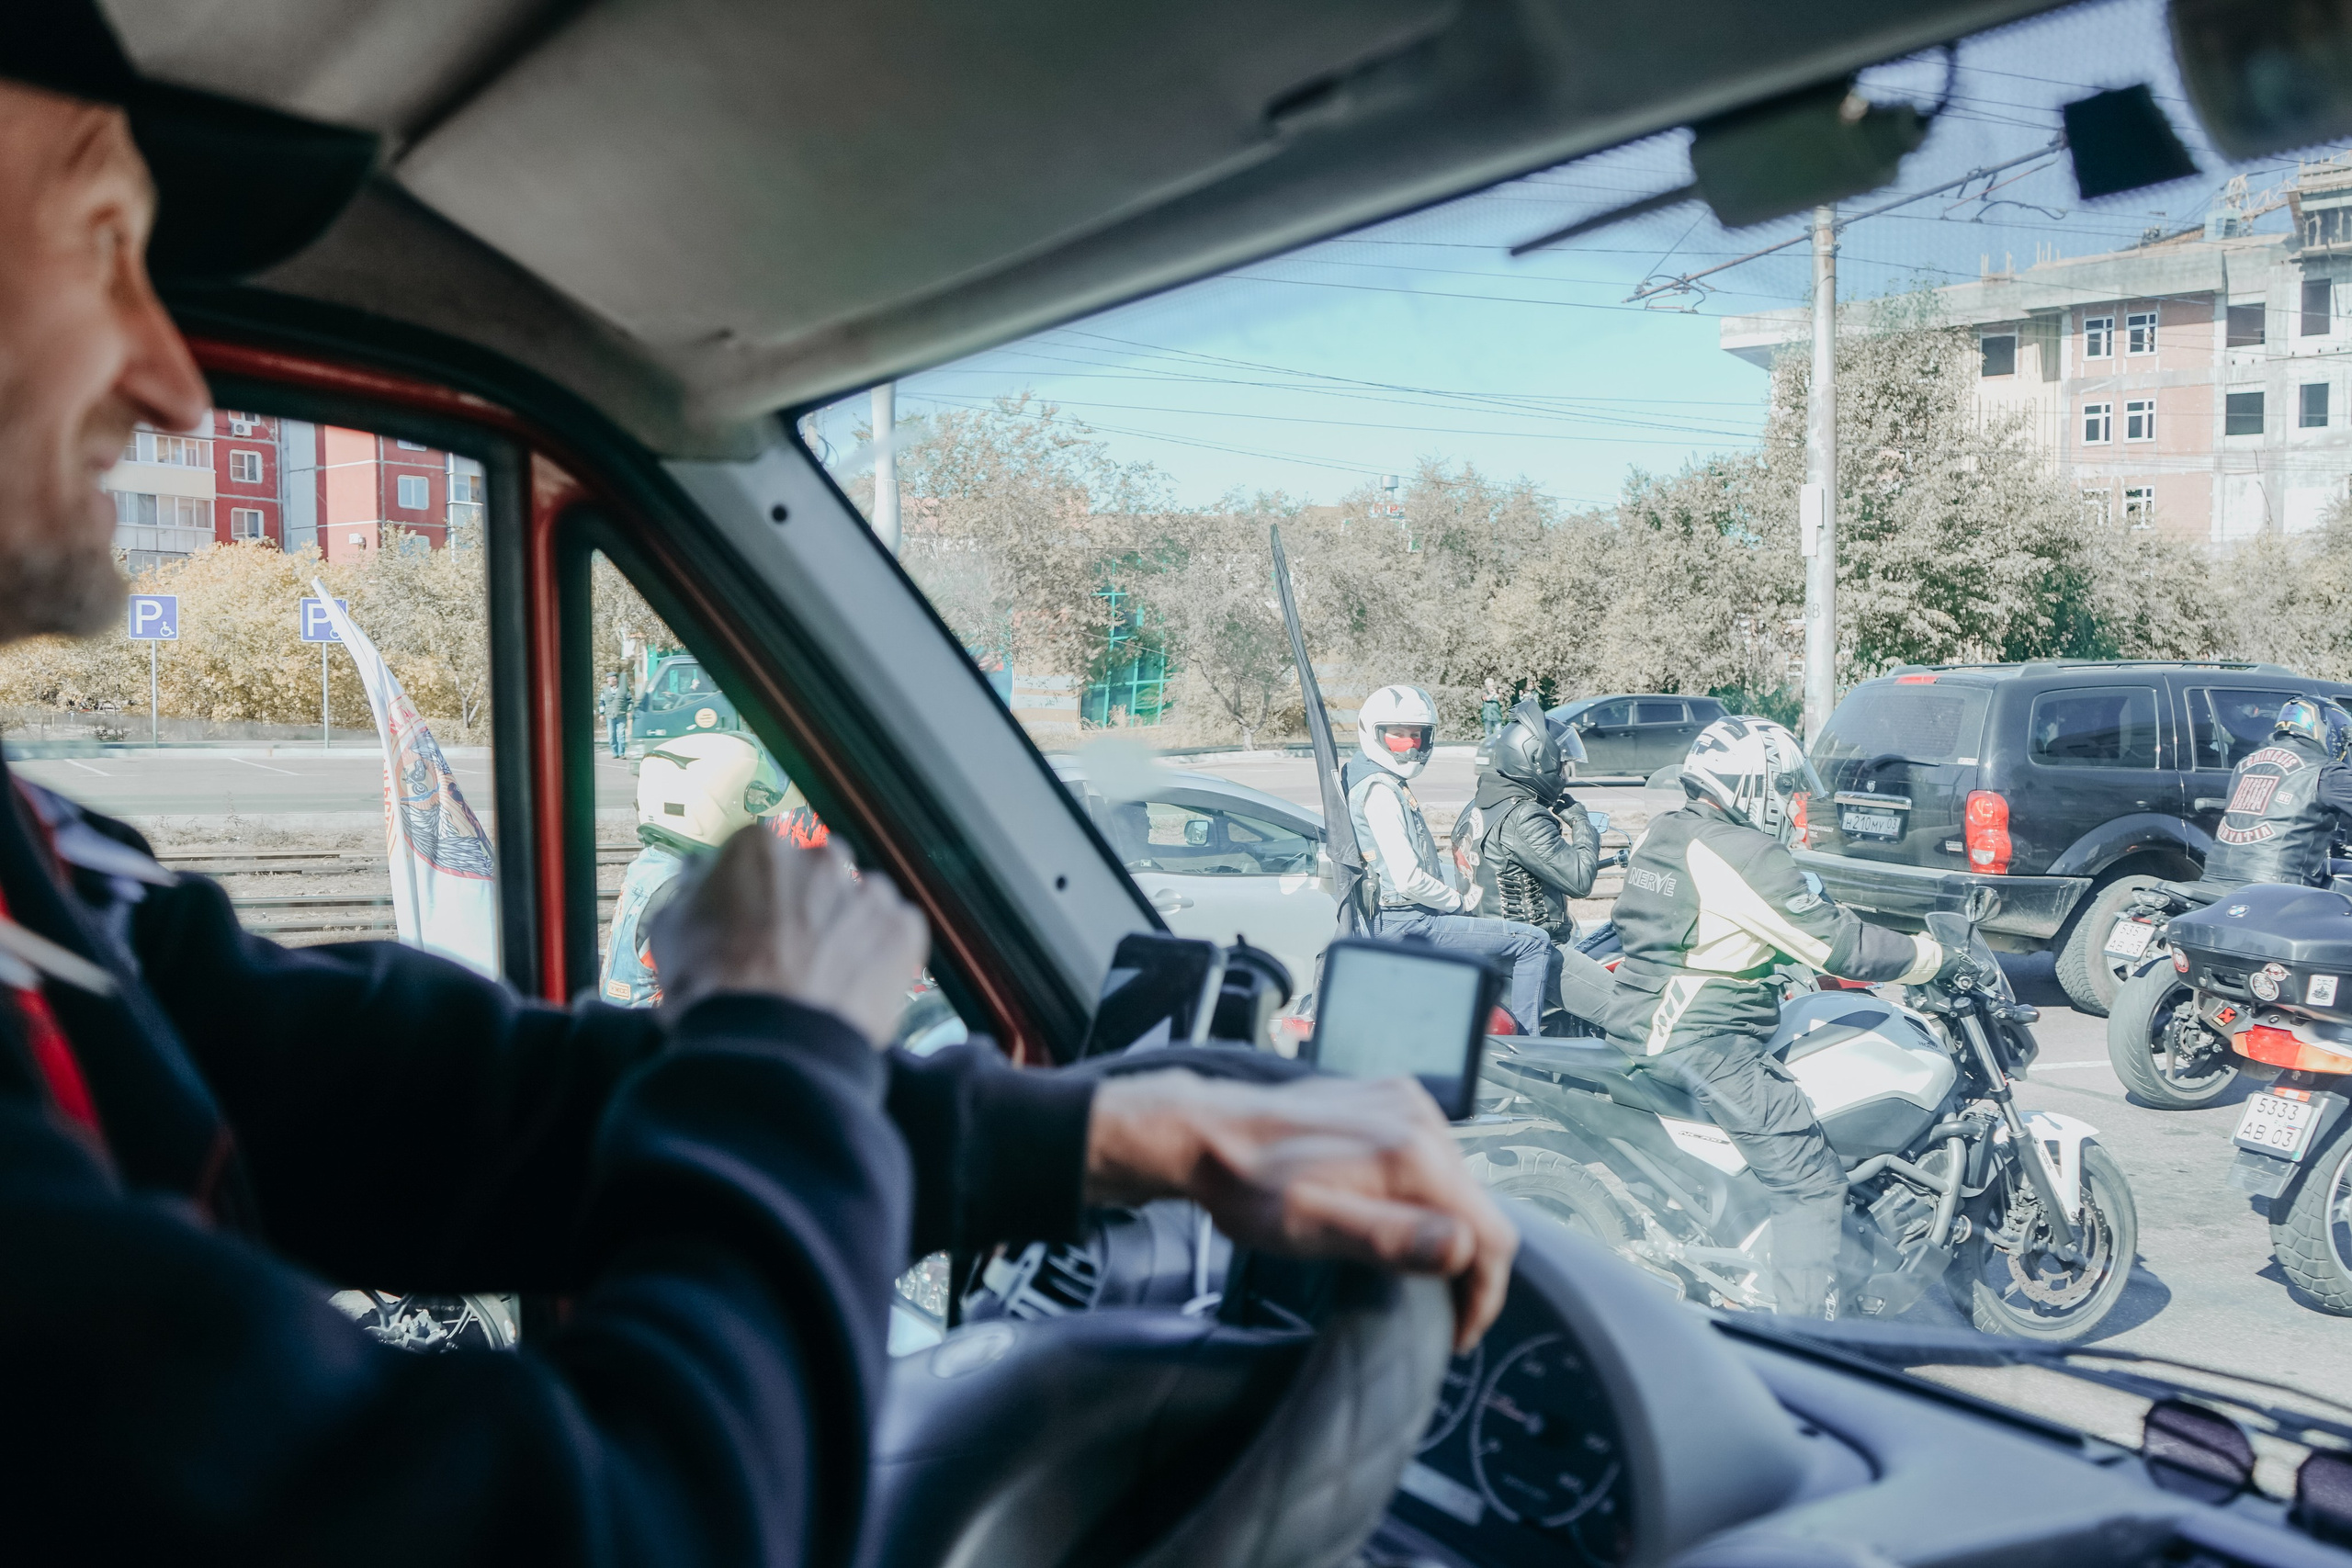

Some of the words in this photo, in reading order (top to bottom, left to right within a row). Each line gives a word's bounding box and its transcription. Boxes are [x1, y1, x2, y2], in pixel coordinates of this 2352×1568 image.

[135, 599, 164, 635] P
[307, 603, 333, 637] P
[2218, 820, 2272, 843] RYATIA
[1627, 866, 1678, 897] NERVE
[2256, 1098, 2300, 1121] 5333
[2271, 1129, 2294, 1147] 03
